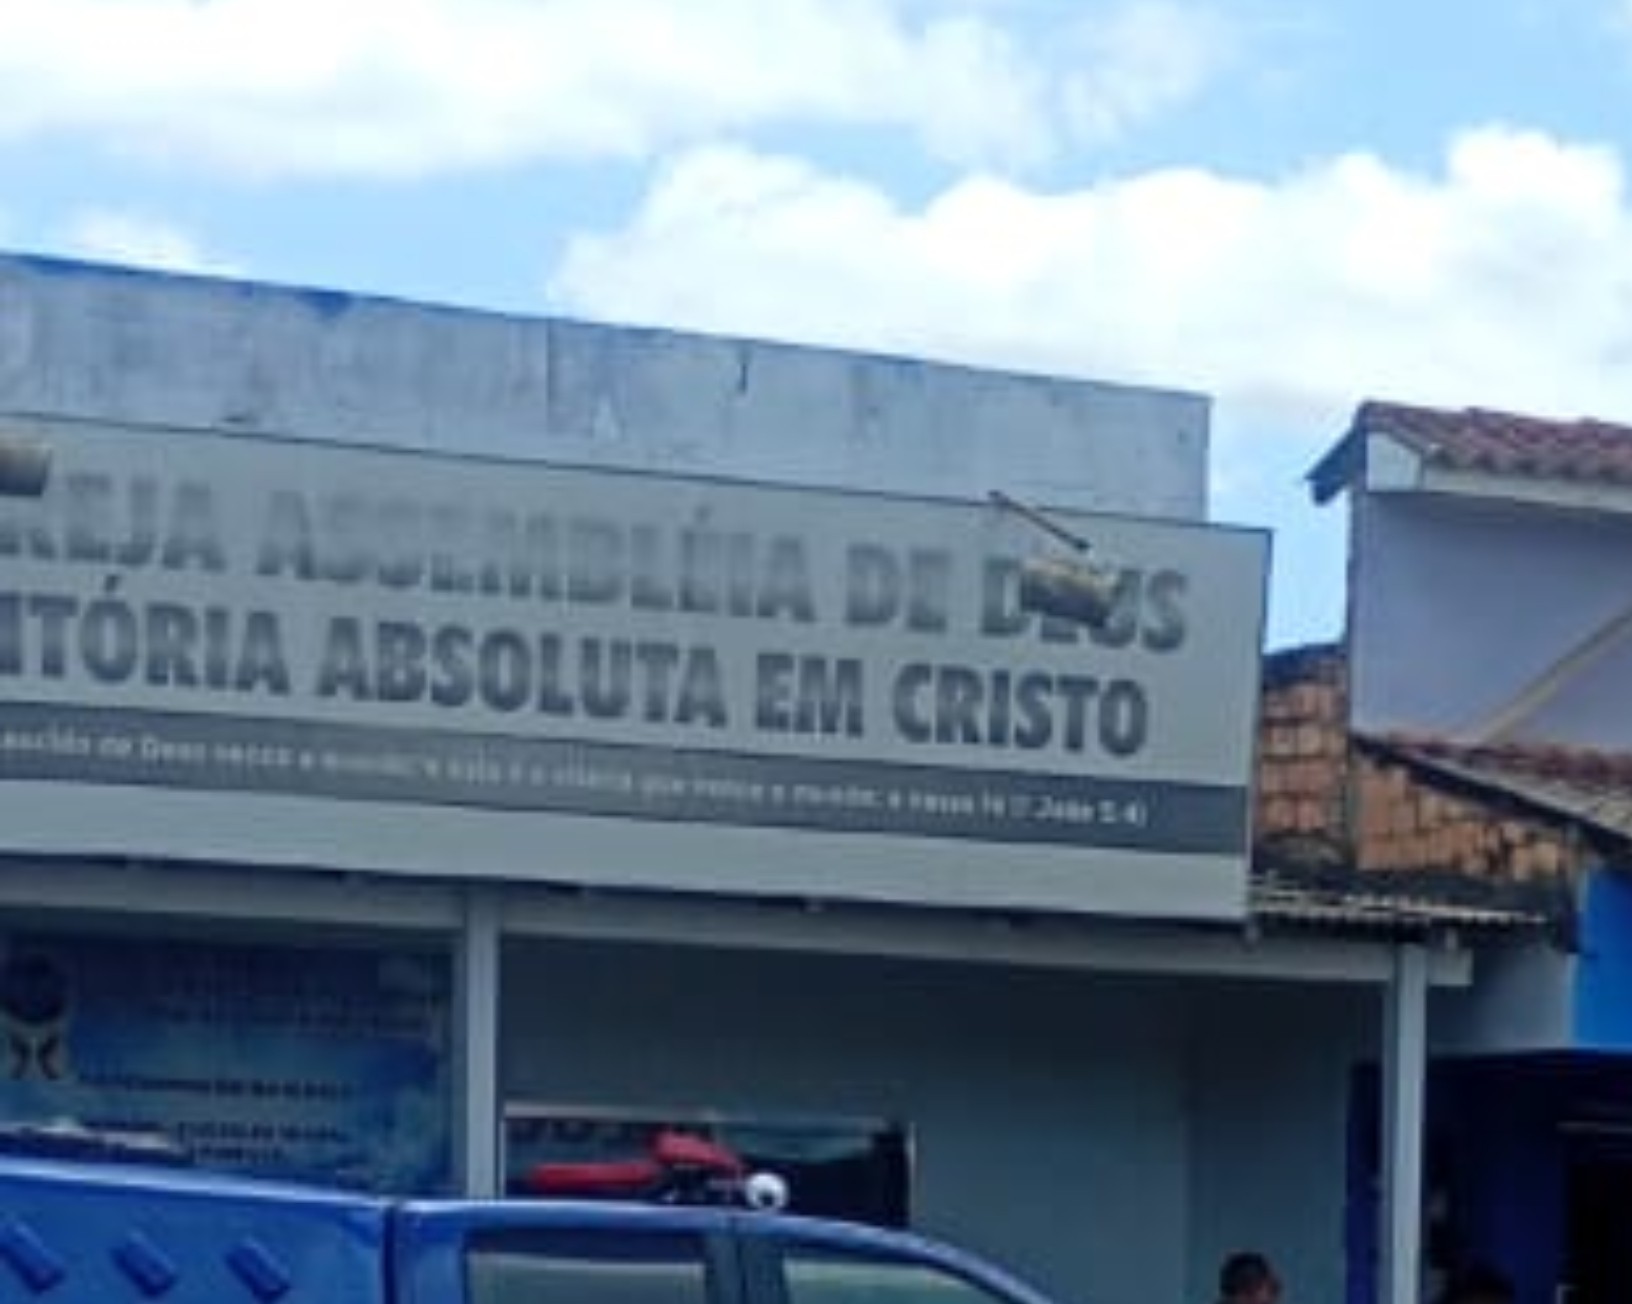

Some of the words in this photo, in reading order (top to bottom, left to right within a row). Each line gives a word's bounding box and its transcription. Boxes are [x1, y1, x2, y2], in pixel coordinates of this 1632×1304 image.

[845, 542, 951, 634] DE
[315, 614, 728, 729] ABSOLUTA
[755, 652, 864, 737] EM
[891, 661, 1149, 756] CRISTO
